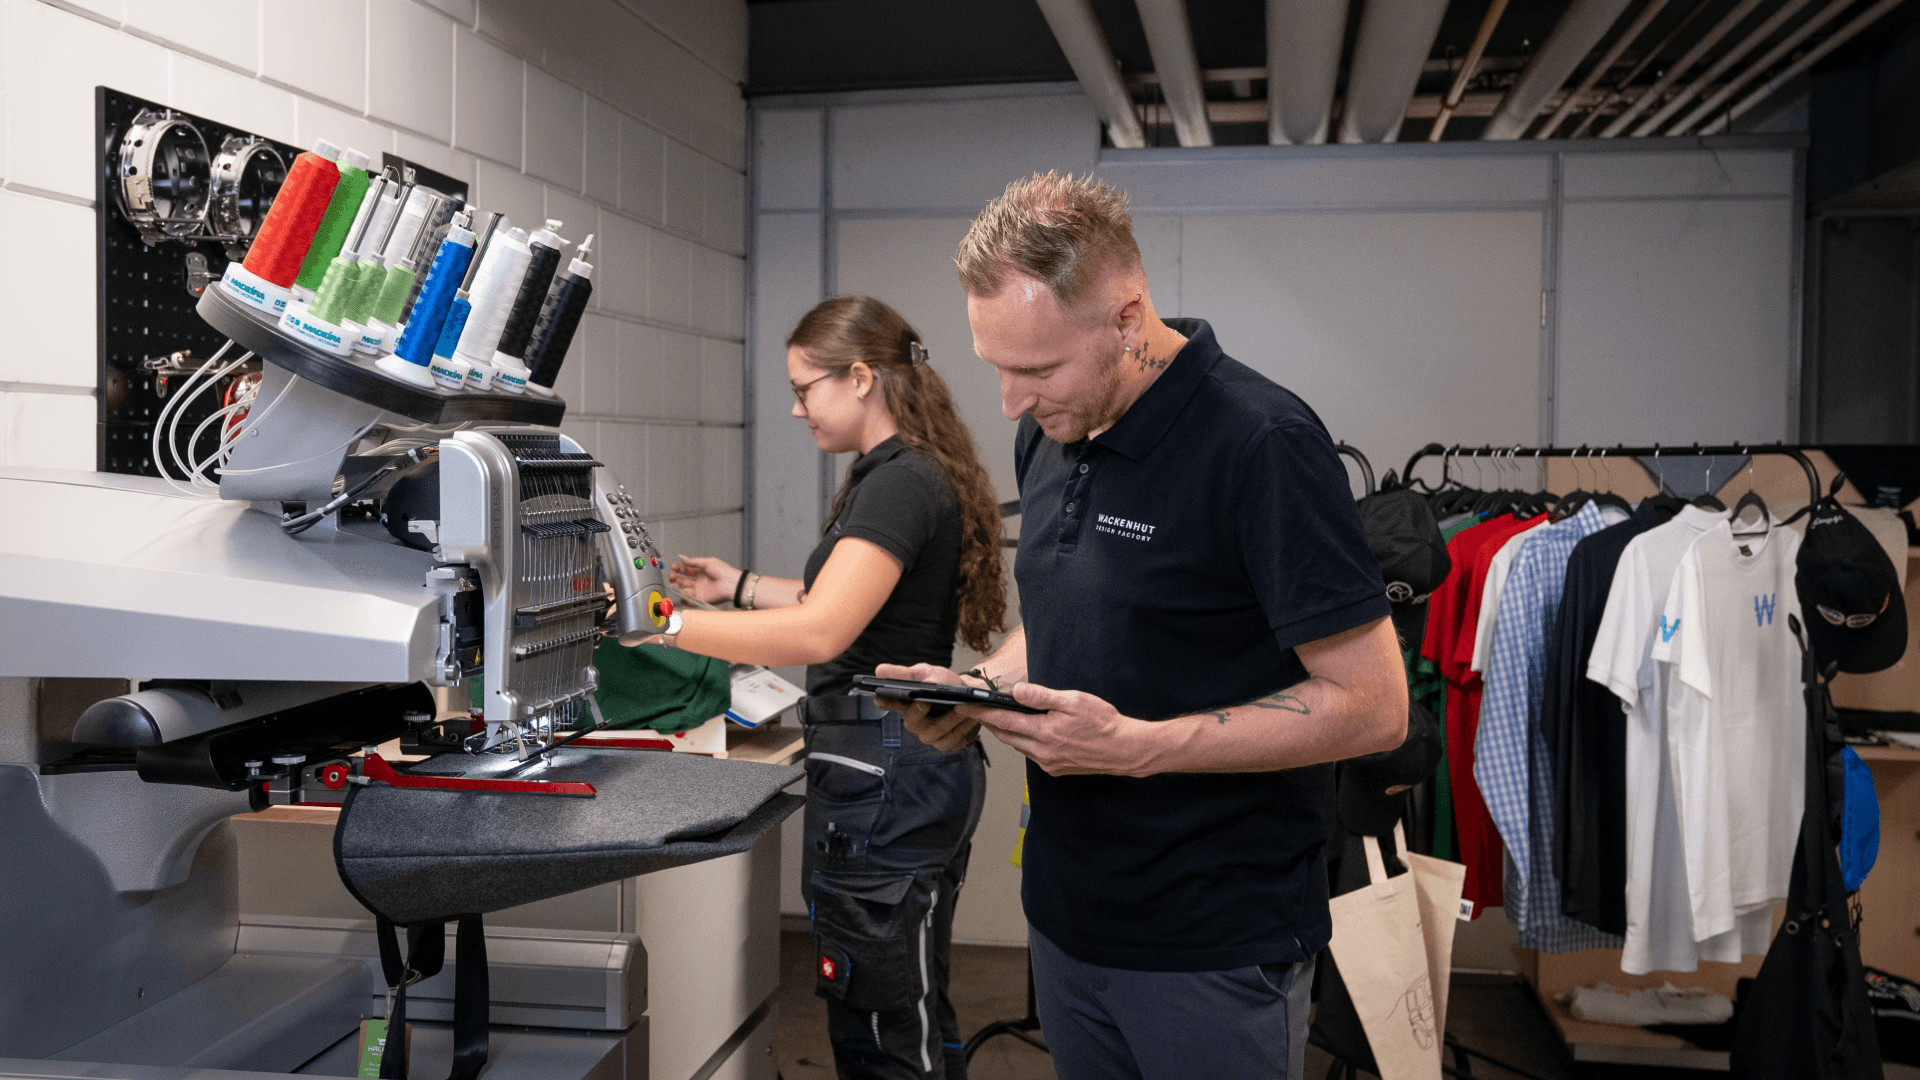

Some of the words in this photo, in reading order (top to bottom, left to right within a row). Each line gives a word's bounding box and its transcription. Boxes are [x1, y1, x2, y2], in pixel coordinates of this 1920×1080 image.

[1095, 524, 1116, 534] DESIGN
[1117, 529, 1151, 542] FACTORY
[1098, 513, 1156, 535] WACKENHUT
